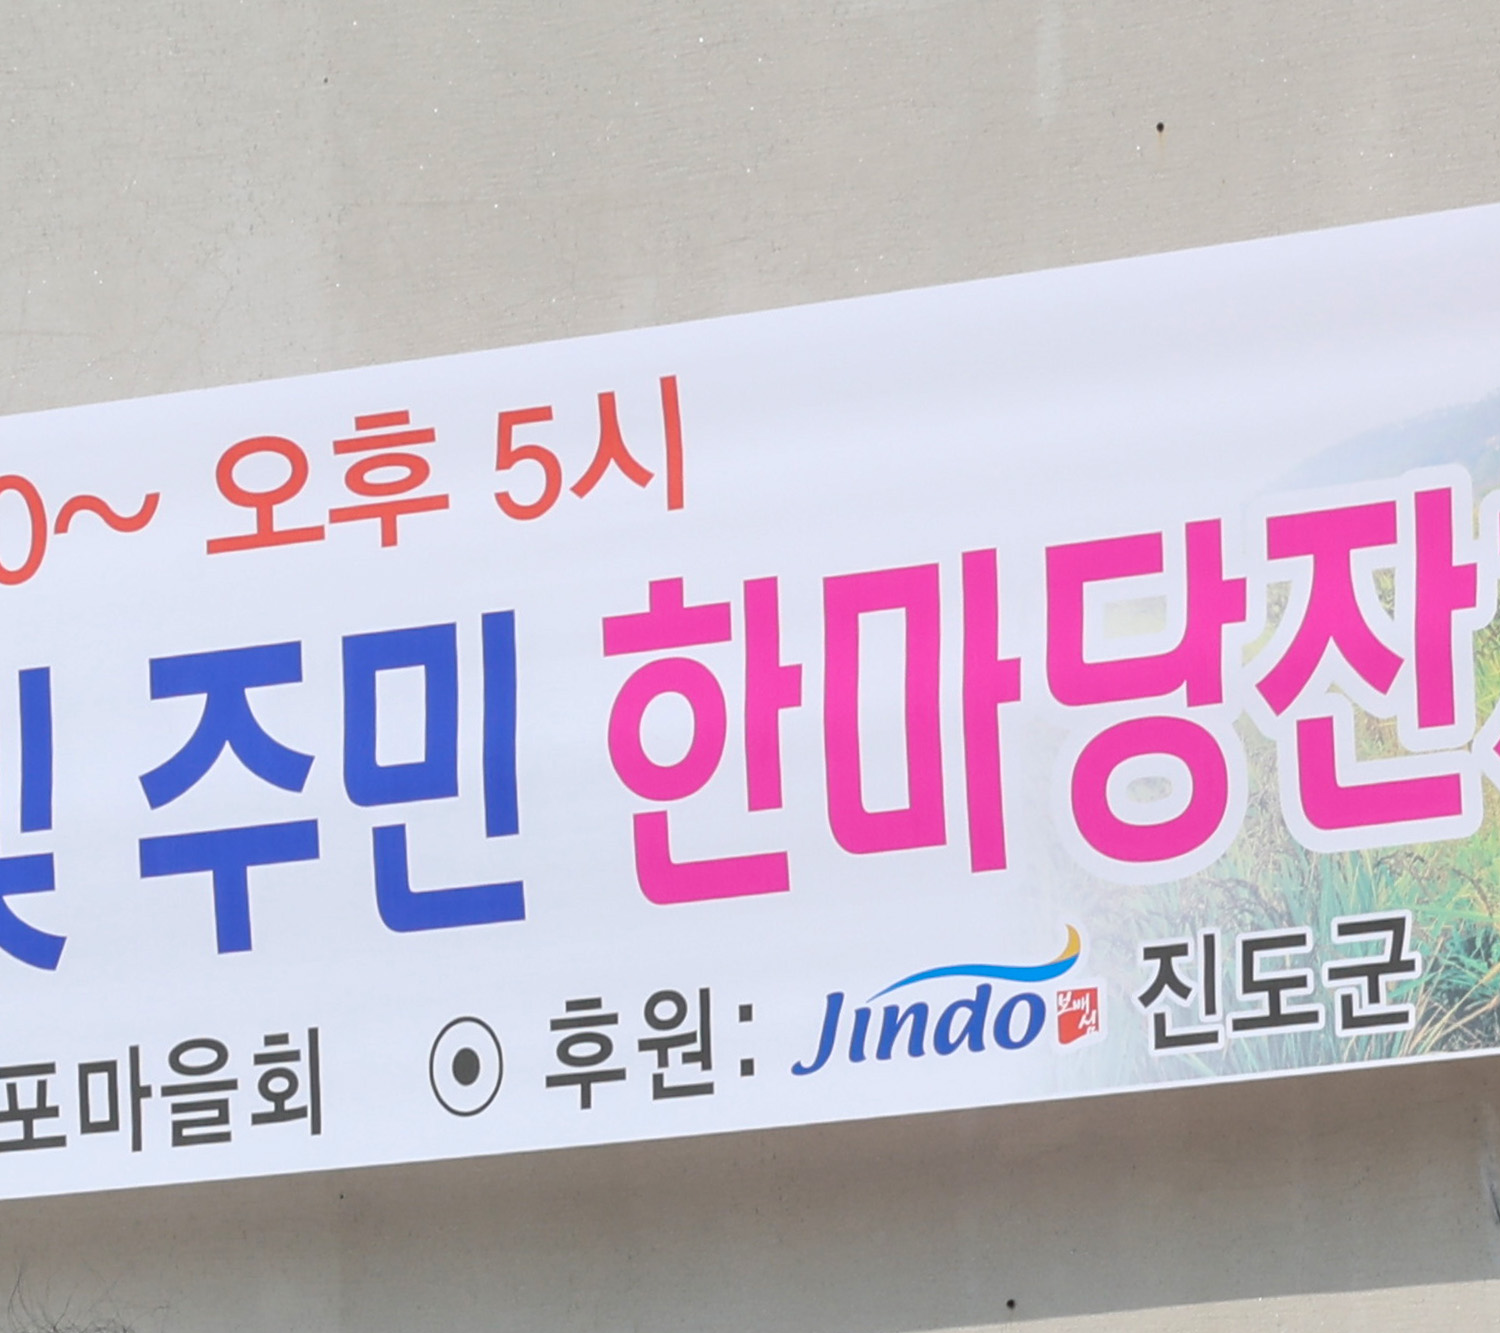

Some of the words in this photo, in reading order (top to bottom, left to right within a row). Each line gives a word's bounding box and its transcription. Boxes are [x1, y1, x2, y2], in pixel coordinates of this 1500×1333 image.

[207, 410, 449, 554] 오후
[496, 376, 684, 521] 5시
[139, 610, 525, 955] 주민
[546, 988, 754, 1109] 후원:
[791, 982, 1046, 1075] Jindo
[1139, 917, 1415, 1049] 진도군
